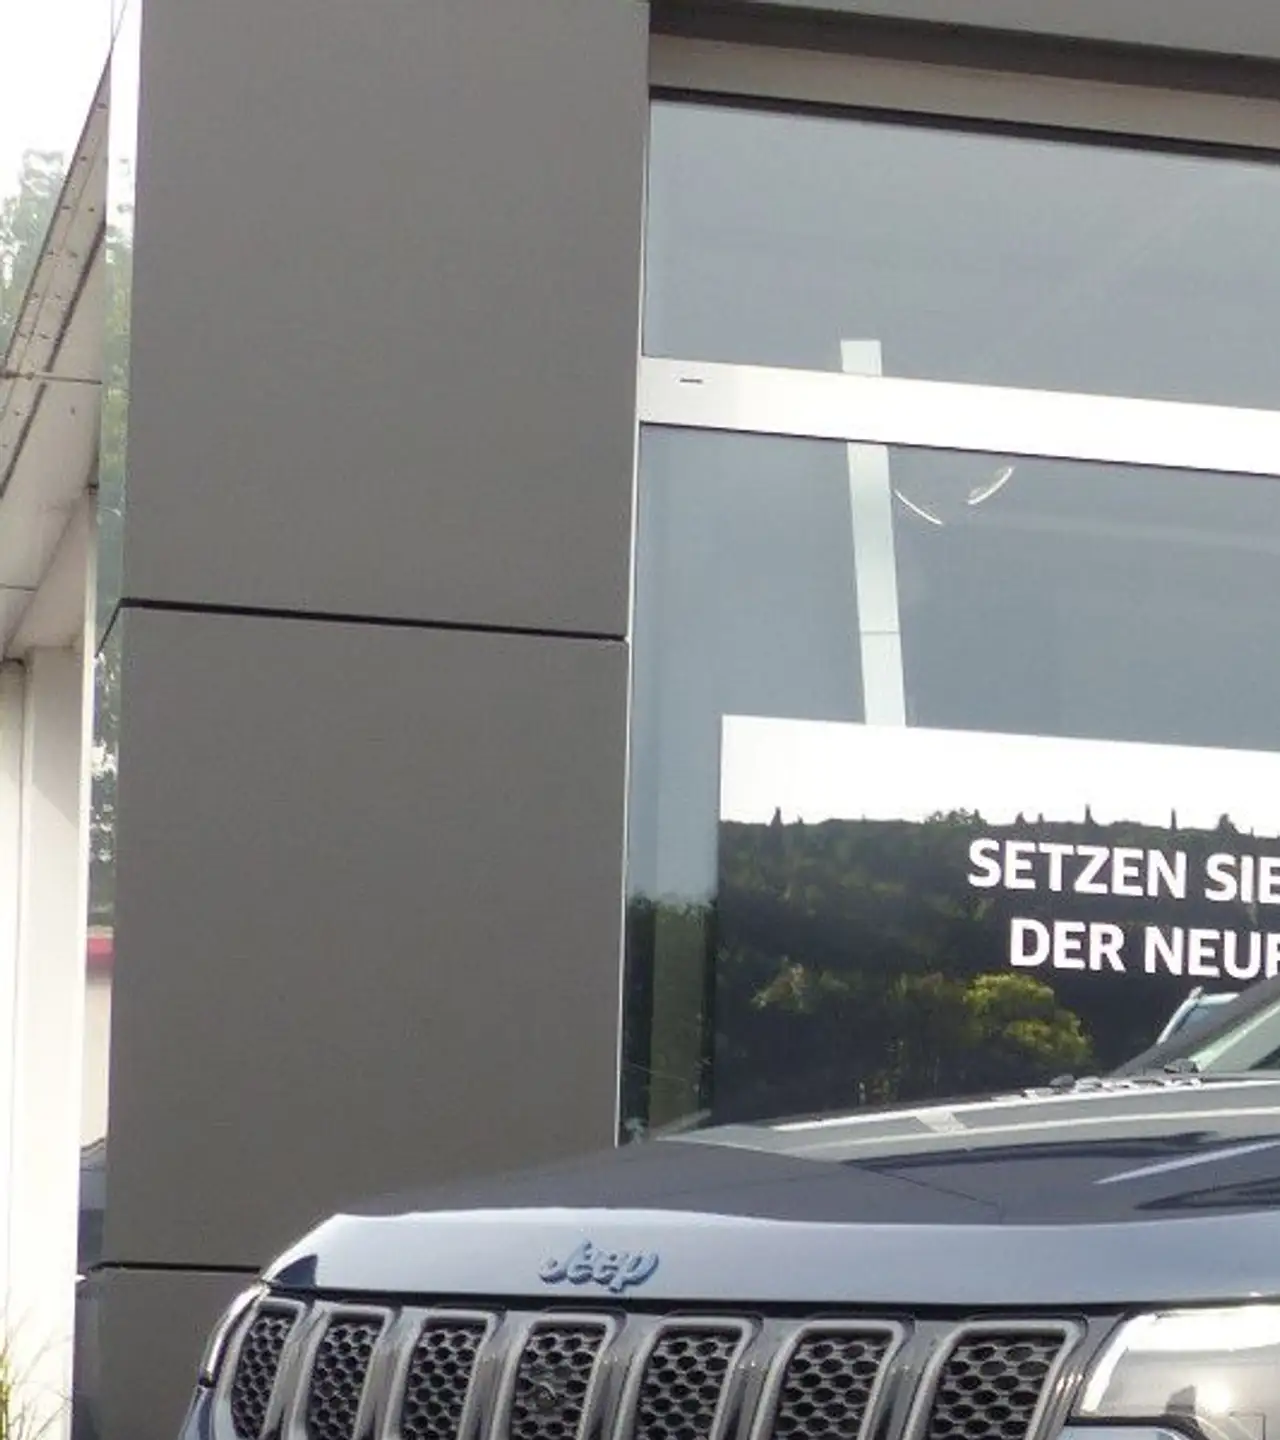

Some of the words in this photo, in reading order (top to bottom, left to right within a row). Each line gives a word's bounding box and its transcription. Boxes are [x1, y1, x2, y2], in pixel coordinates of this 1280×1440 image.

[967, 838, 1187, 899] SETZEN
[1009, 917, 1124, 971] DER
[538, 1239, 661, 1293] Jeep
